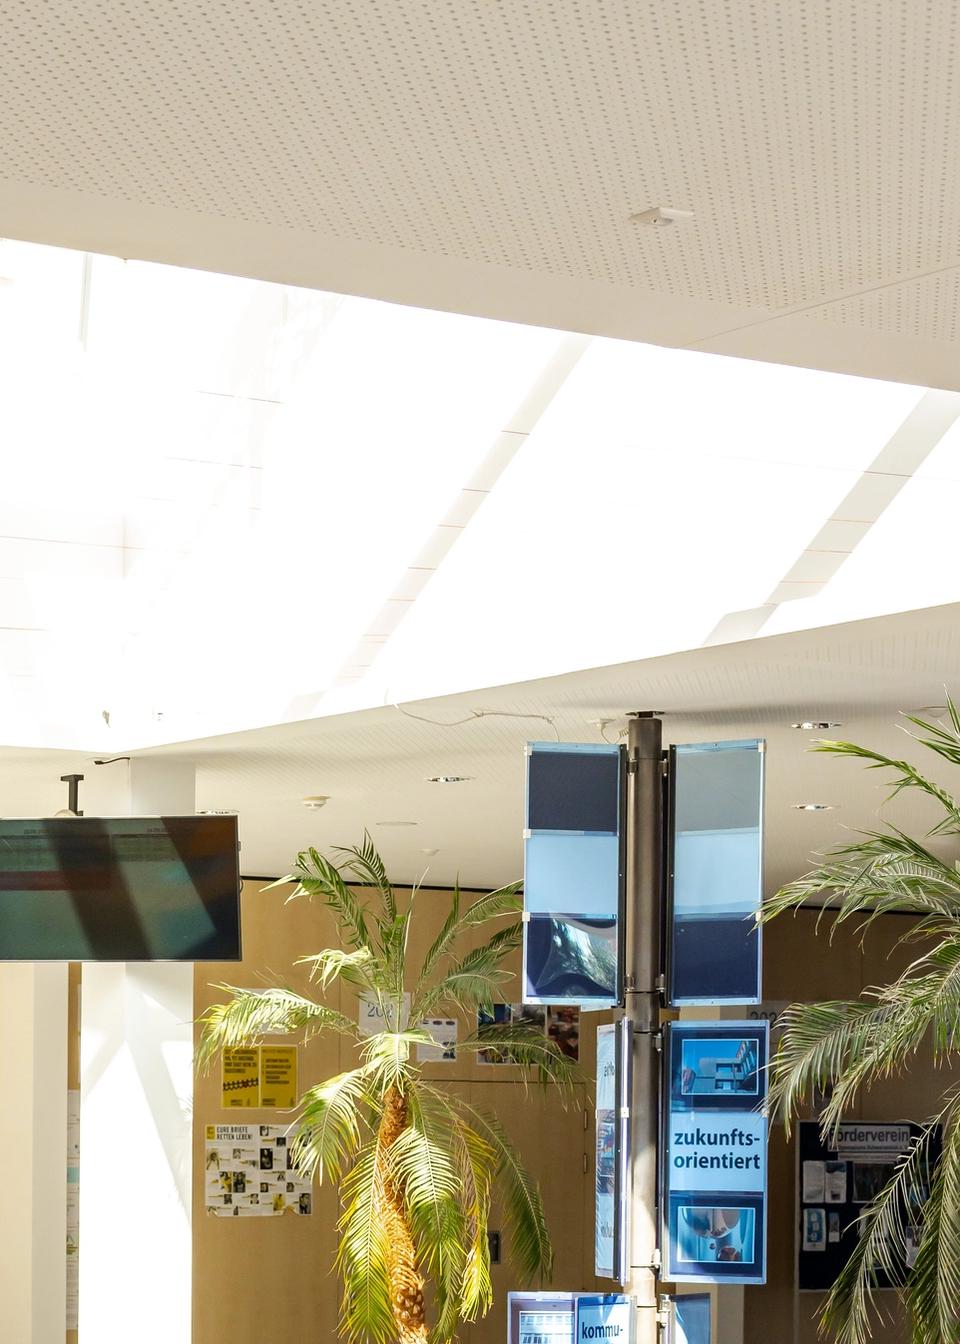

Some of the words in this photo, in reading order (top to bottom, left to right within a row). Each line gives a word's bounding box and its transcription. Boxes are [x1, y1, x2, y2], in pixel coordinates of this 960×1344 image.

[674, 1128, 760, 1146] zukunfts-
[674, 1152, 760, 1169] orientiert
[581, 1321, 623, 1339] kommu-
